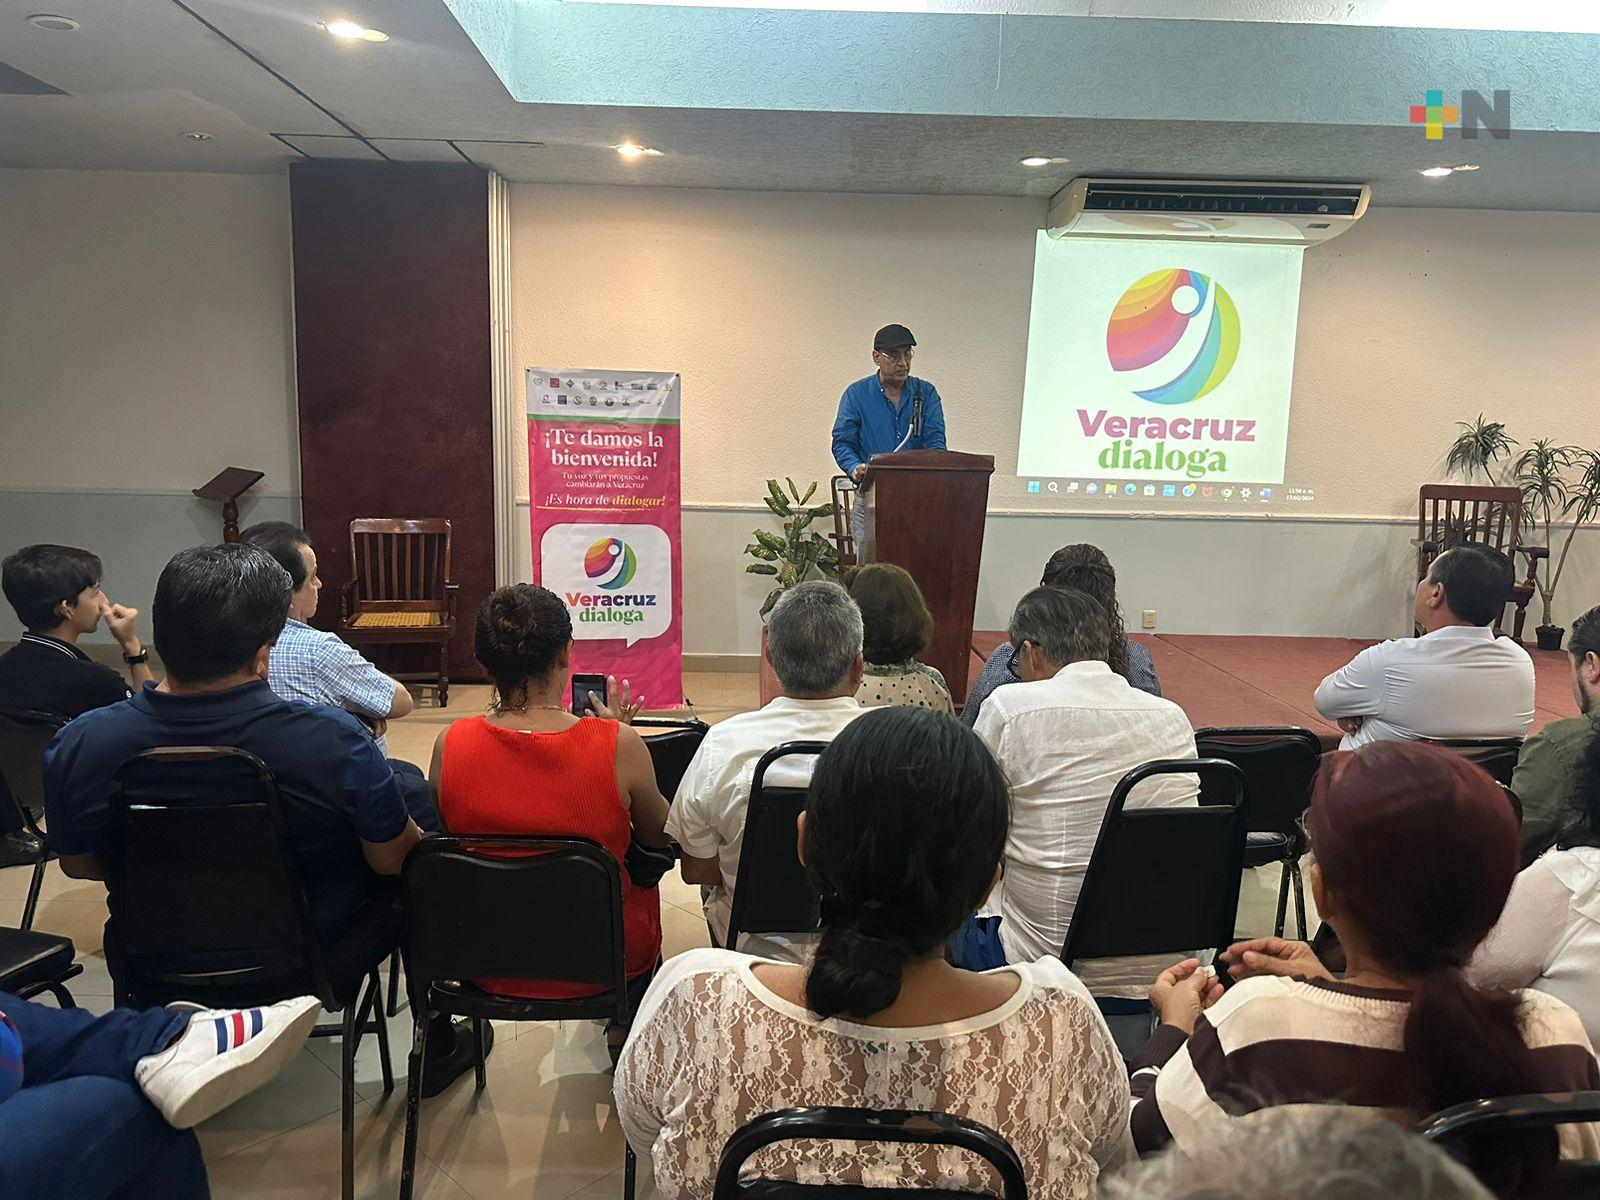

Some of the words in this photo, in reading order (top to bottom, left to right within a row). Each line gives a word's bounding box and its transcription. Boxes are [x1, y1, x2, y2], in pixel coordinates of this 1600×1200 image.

[1076, 409, 1256, 442] Veracruz
[545, 428, 574, 448] ¡Te
[580, 430, 642, 447] damos
[648, 431, 664, 448] la
[551, 449, 658, 468] bienvenida!
[1098, 439, 1228, 478] dialoga
[545, 494, 562, 506] ¡Es
[566, 494, 592, 505] hora
[596, 495, 610, 505] de
[612, 495, 666, 508] dialogar!
[566, 592, 656, 607] Veracruz
[579, 607, 644, 625] dialoga
